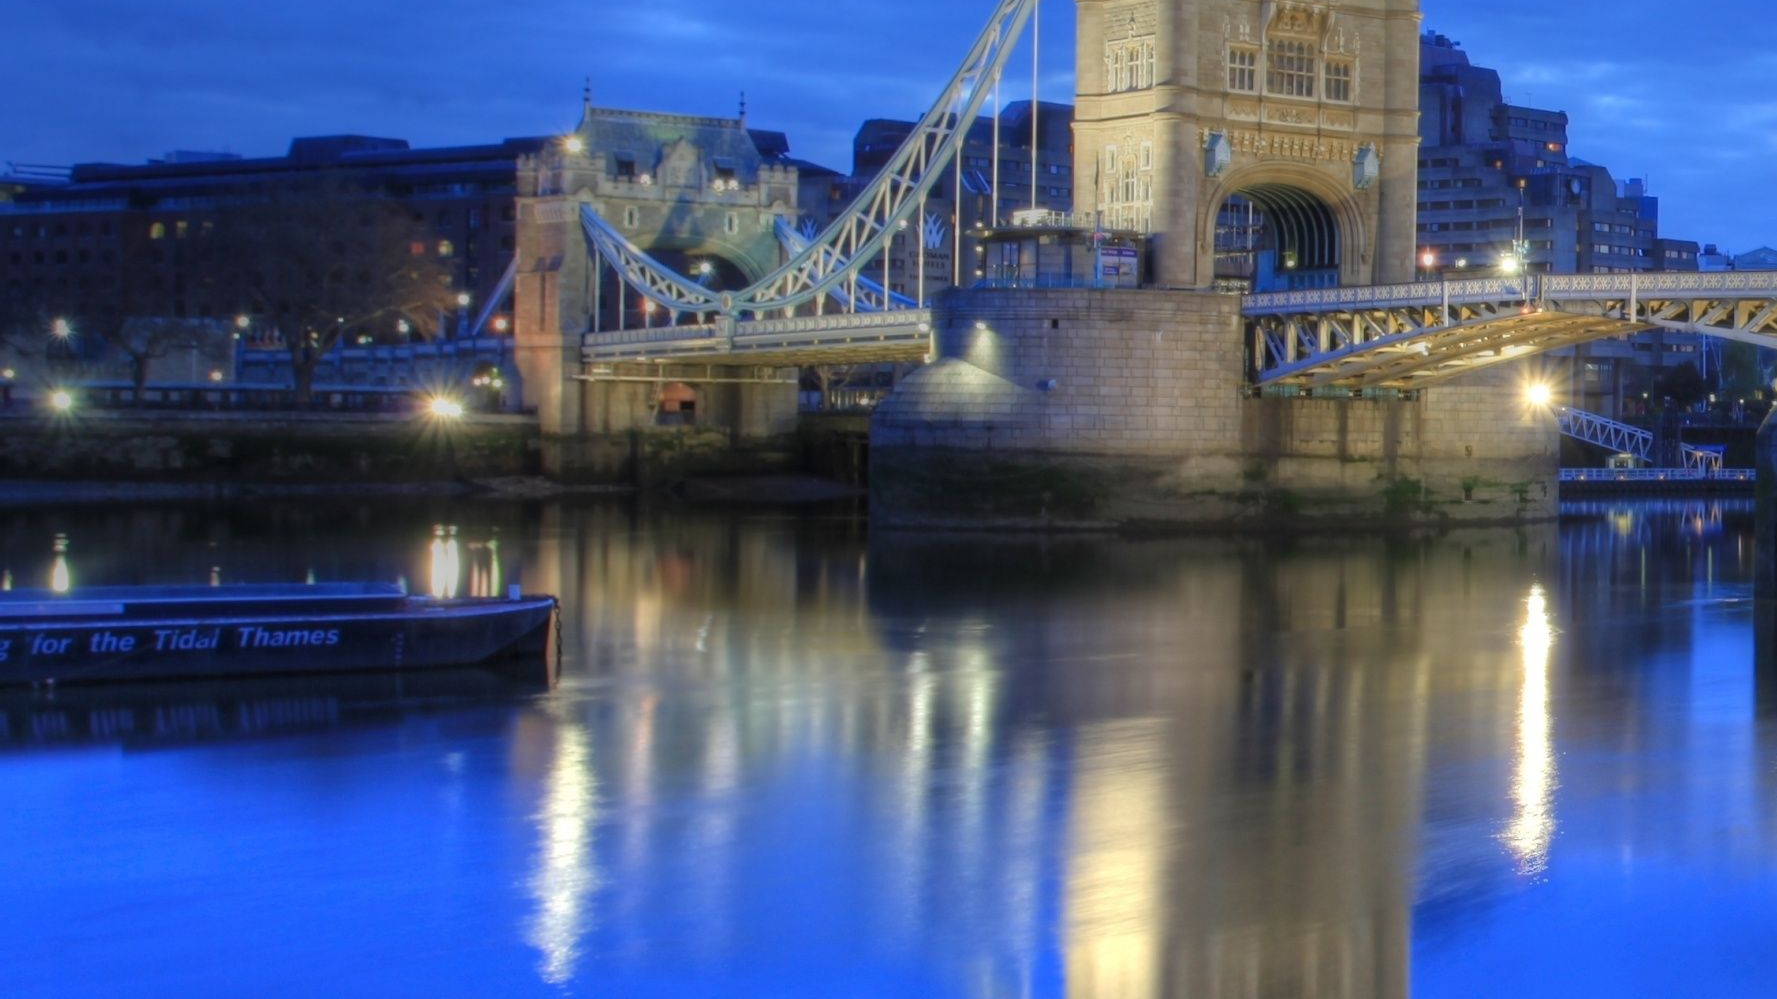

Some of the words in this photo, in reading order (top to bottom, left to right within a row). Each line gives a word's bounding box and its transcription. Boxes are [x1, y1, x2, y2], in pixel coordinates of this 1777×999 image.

[31, 633, 72, 655] for
[90, 631, 135, 652] the
[154, 628, 221, 650] Tidal
[237, 626, 340, 647] Thames
